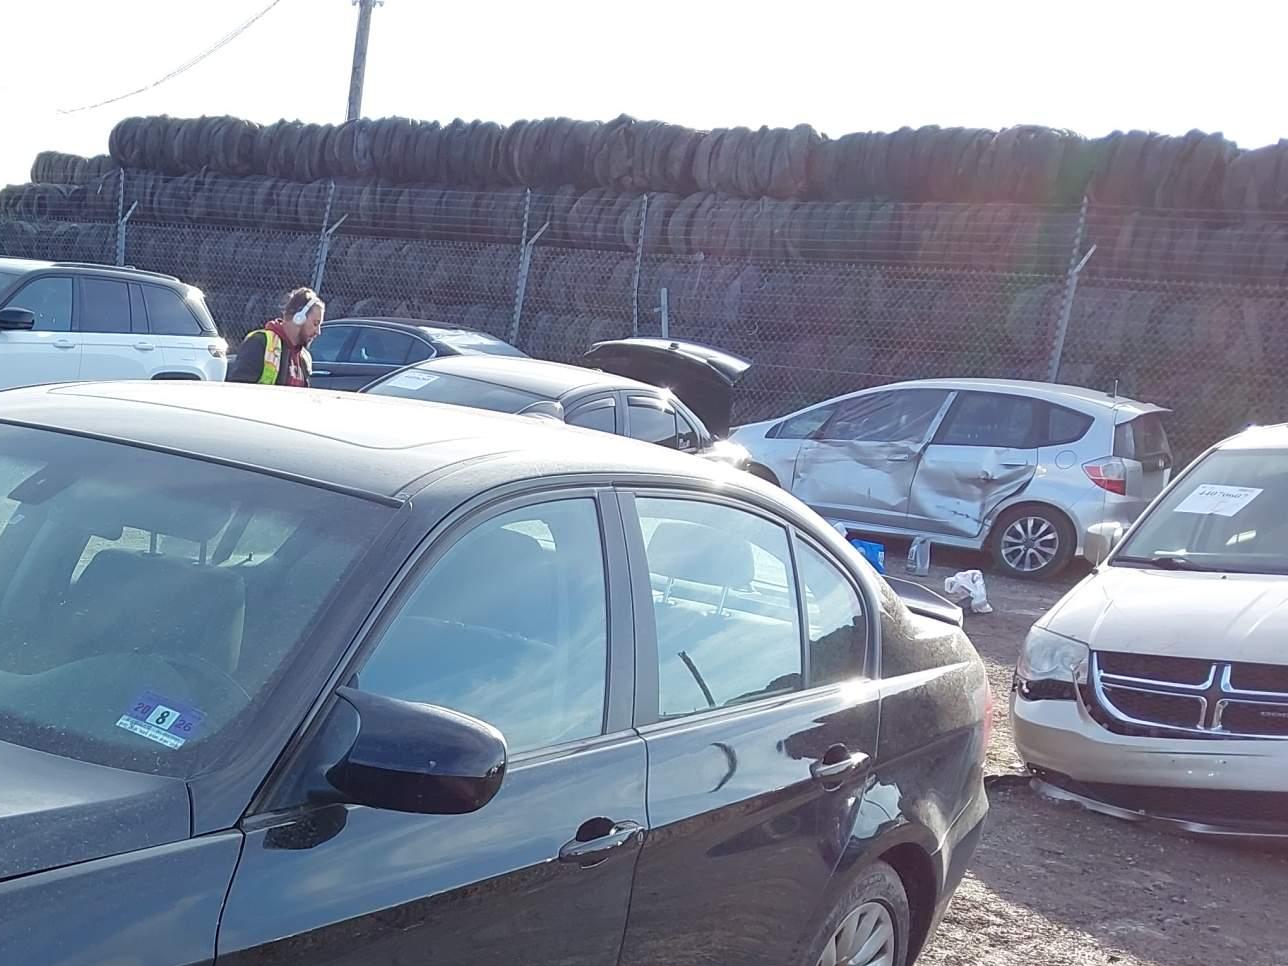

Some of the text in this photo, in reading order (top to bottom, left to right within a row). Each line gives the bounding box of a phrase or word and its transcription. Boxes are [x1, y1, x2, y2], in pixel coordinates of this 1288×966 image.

[134, 702, 193, 732] 20 8 26
